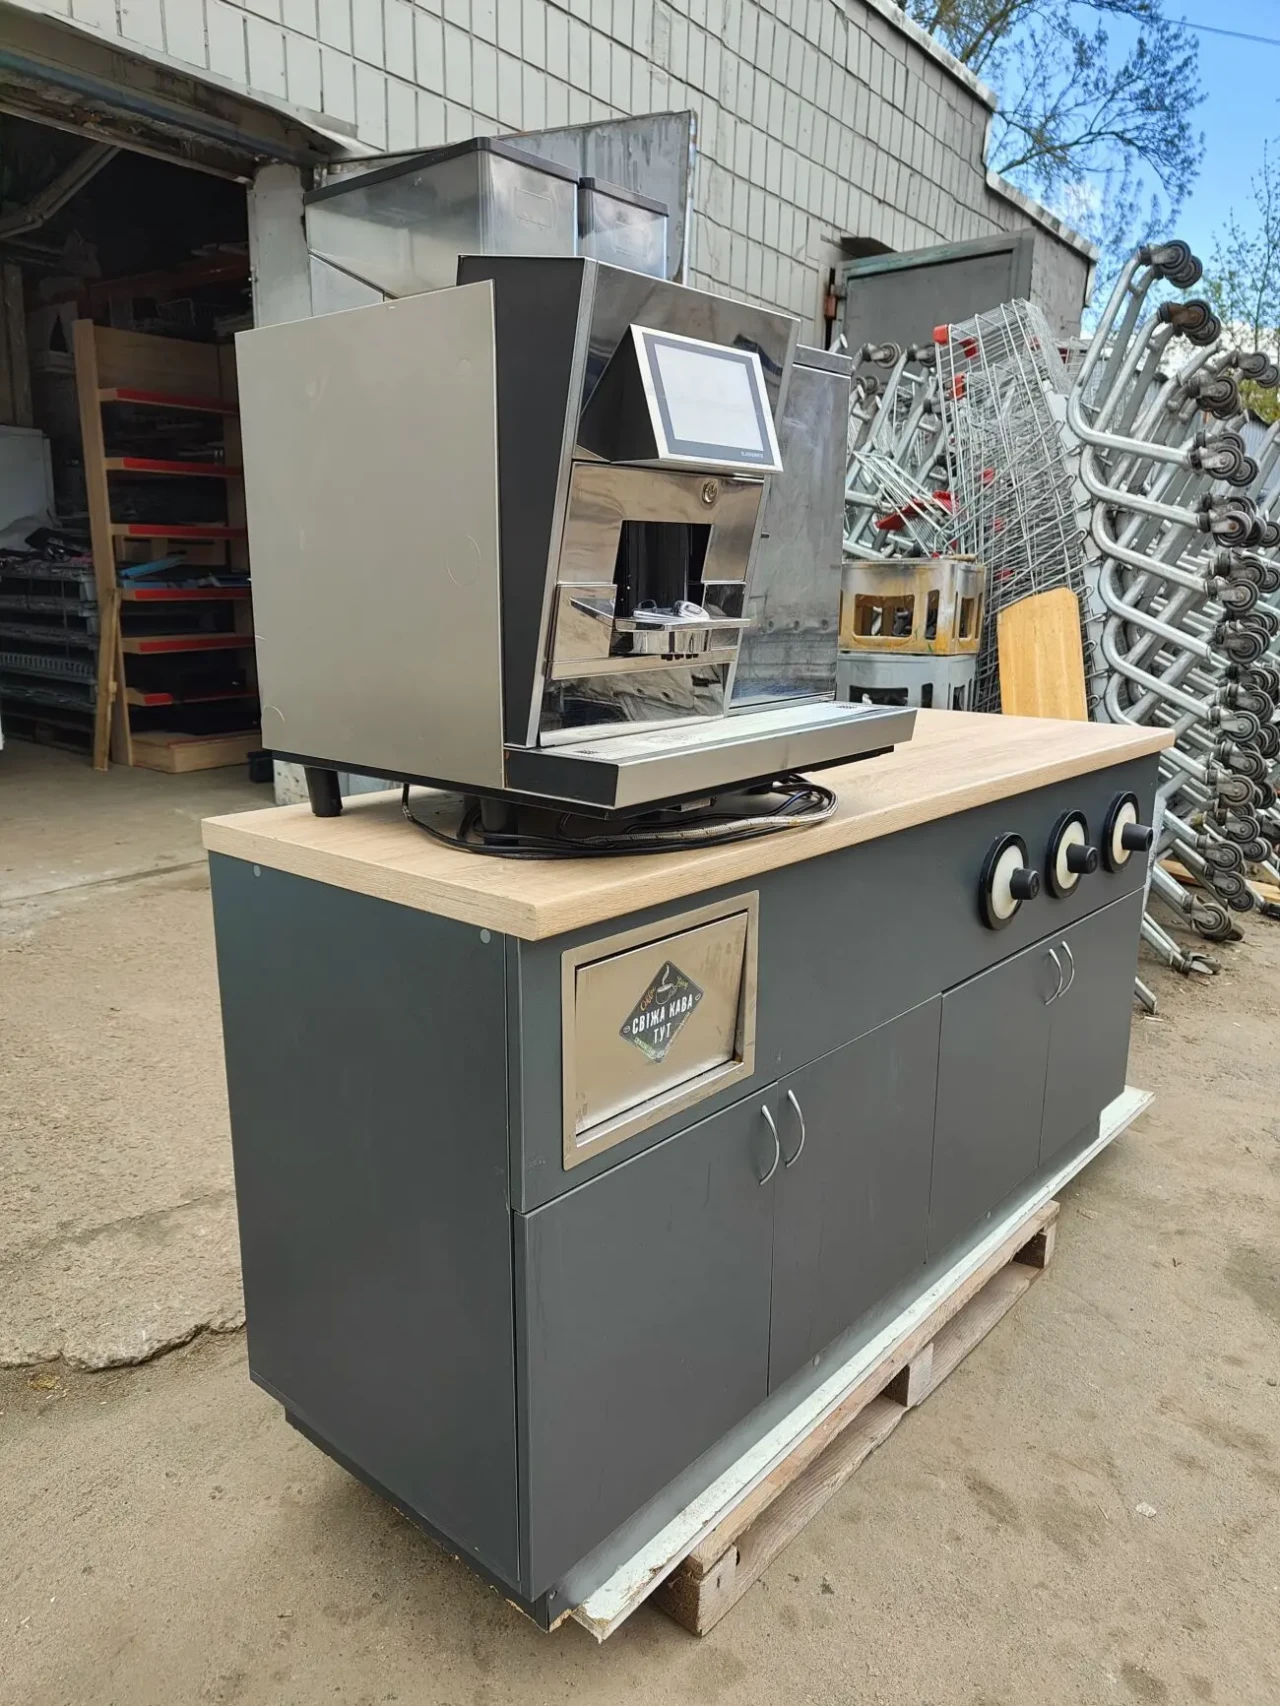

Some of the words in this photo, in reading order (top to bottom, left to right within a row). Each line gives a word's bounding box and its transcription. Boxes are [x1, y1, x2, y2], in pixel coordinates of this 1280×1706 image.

[632, 1006, 665, 1035] СВІЖА
[669, 994, 693, 1018] КАВА
[654, 1022, 672, 1044] ТУТ
